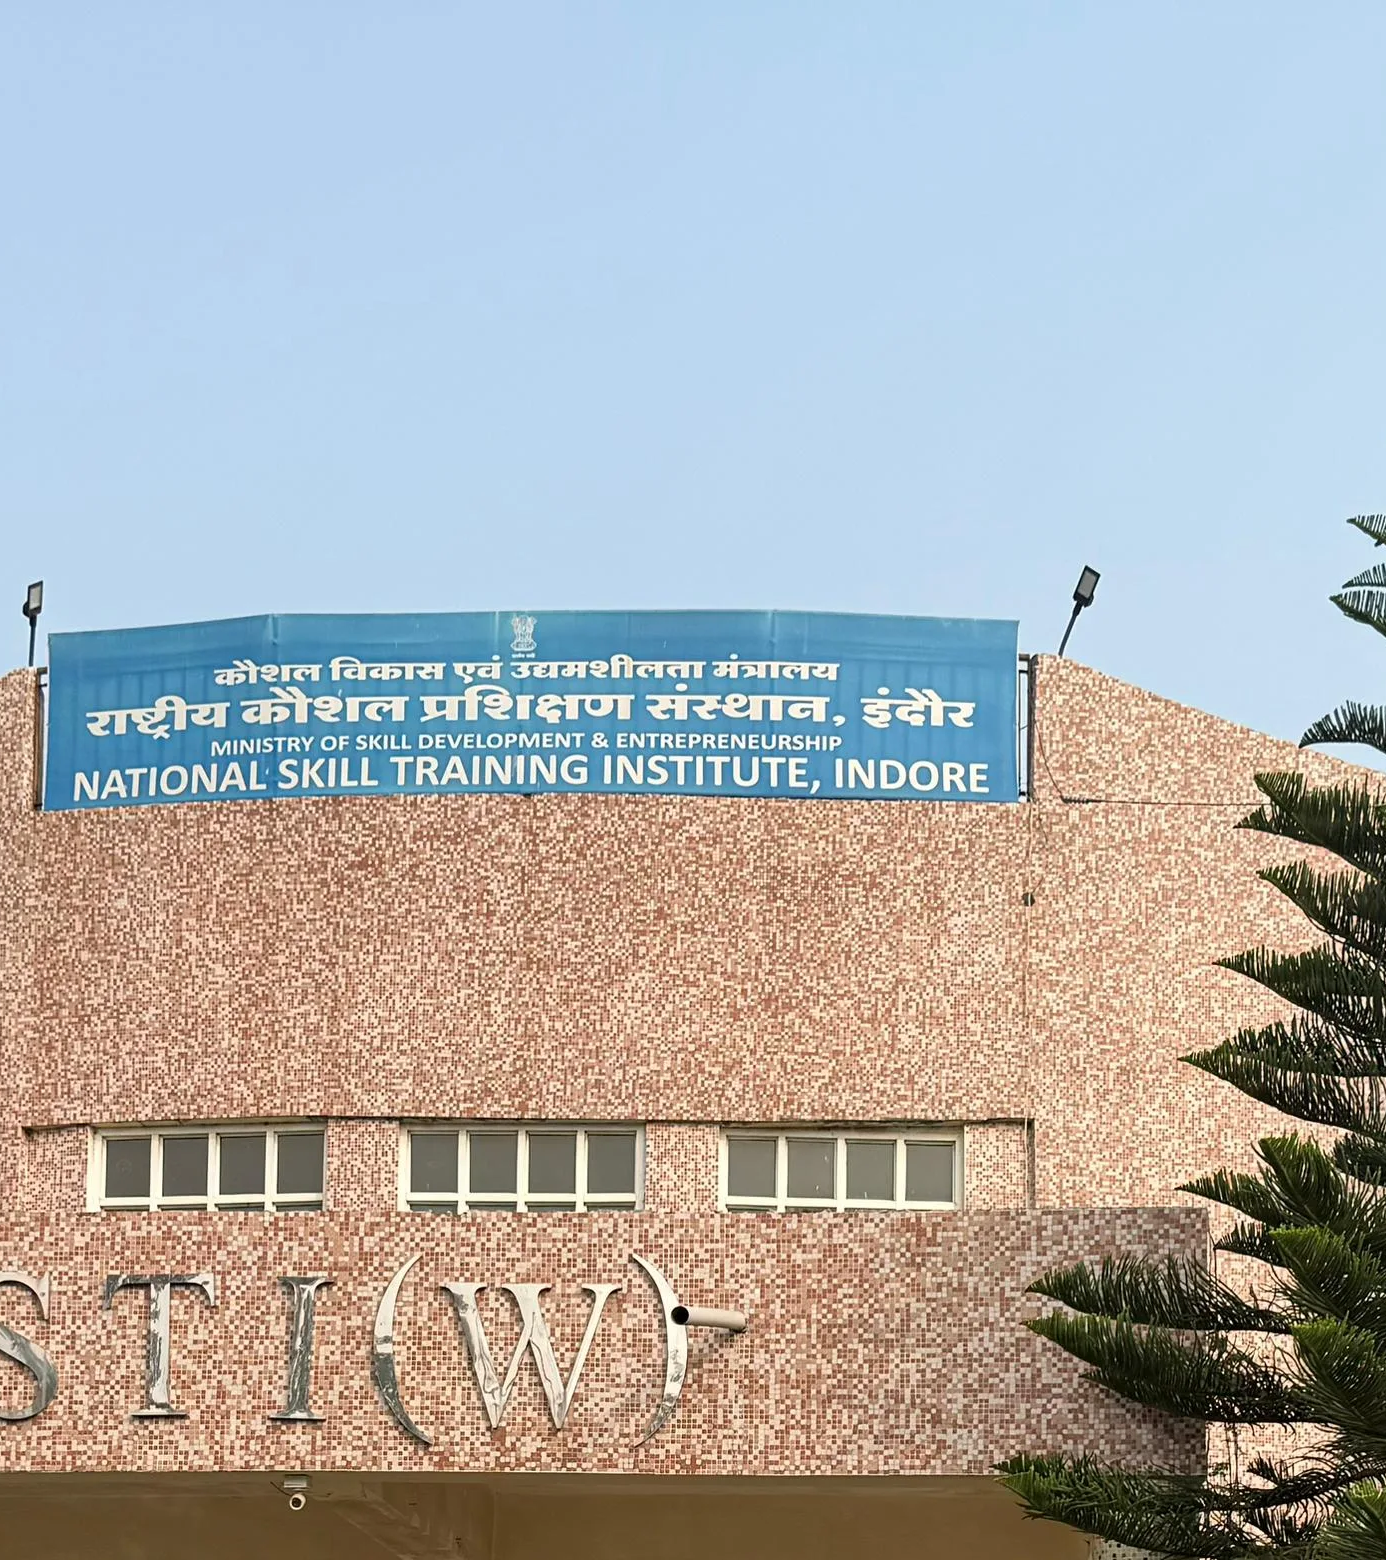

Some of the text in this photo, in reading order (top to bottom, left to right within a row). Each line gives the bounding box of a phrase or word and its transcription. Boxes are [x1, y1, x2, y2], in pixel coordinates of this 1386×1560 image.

[214, 653, 841, 686] कौशल विकास एवं उद्यमशीलता मंत्रालय
[85, 683, 976, 740] राष्ट्रीय कौशल प्रशिक्षण संस्थान, इंदौर
[211, 732, 843, 757] MINISTRY OF SKILL DEVELOPMENT & ENTREPRENEURSHIP
[73, 754, 990, 802] NATIONAL SKILL TRAINING INSTITUTE, INDORE
